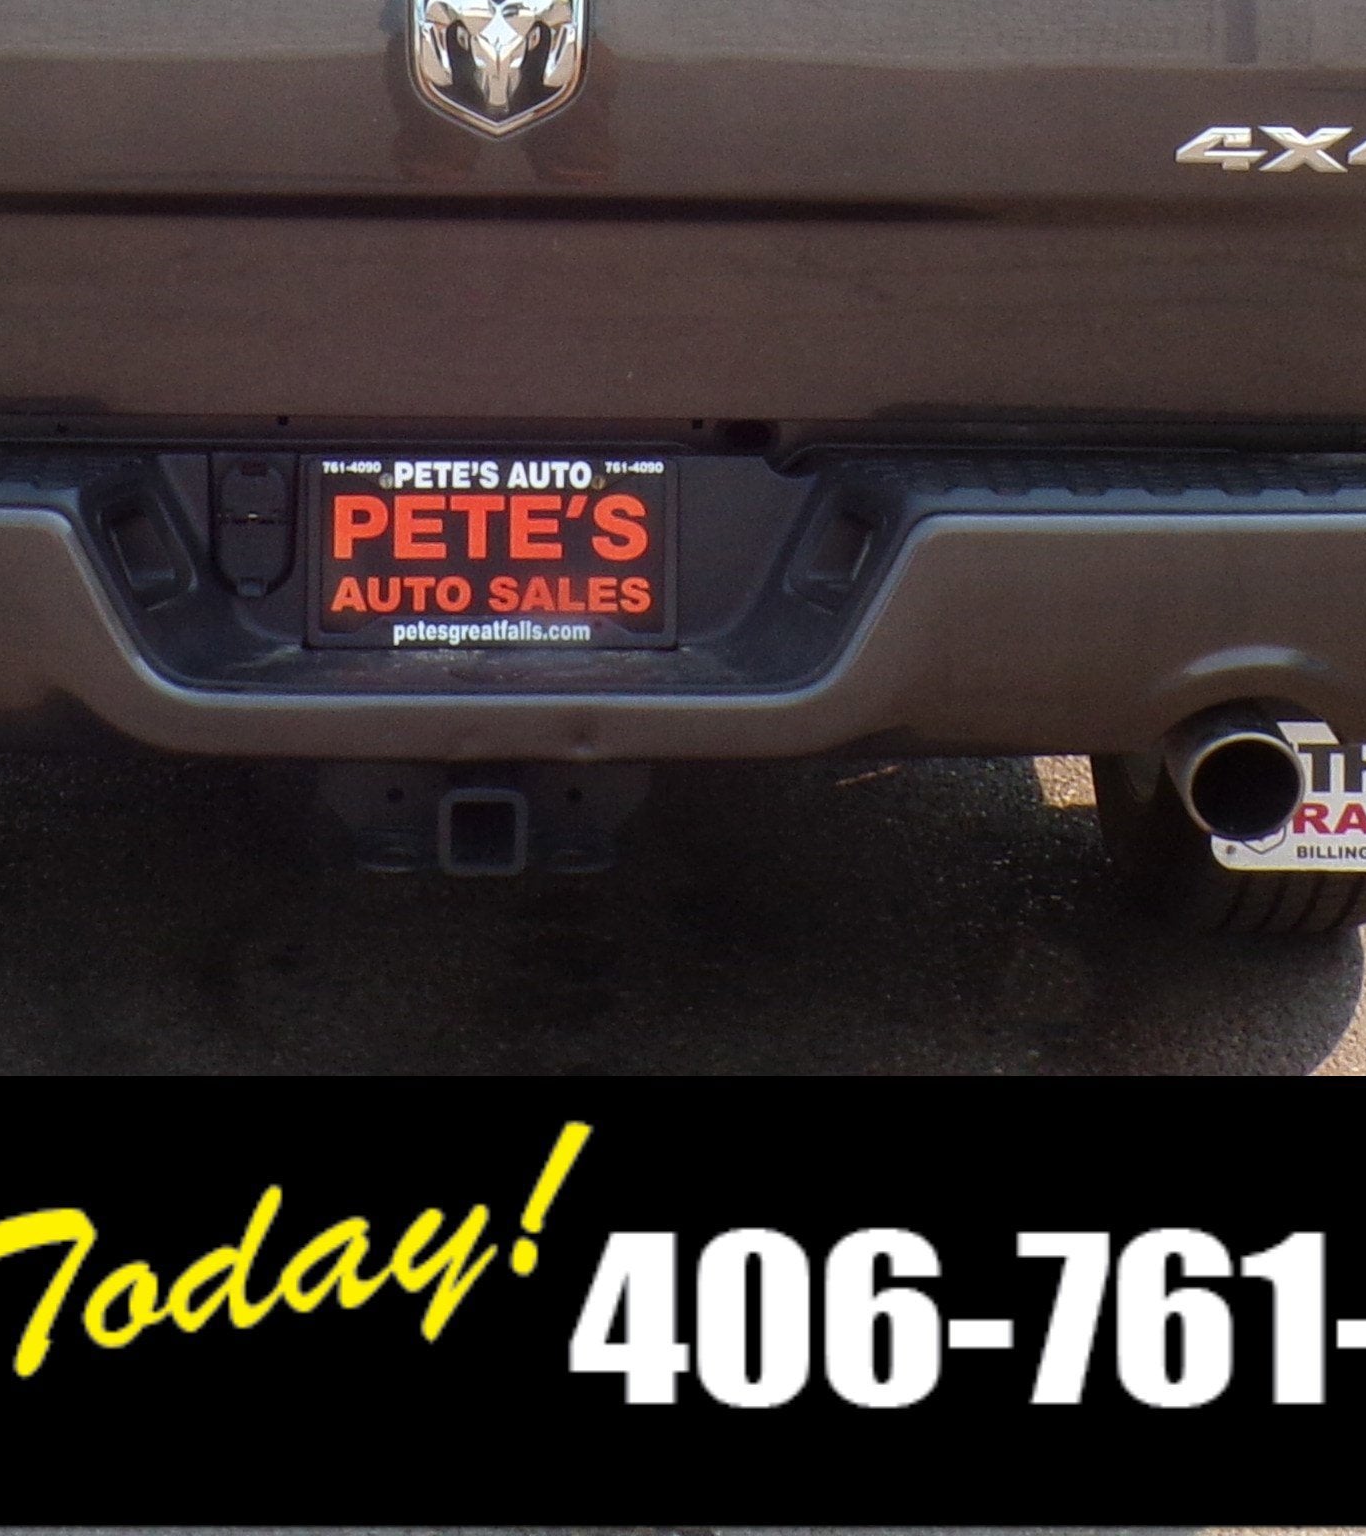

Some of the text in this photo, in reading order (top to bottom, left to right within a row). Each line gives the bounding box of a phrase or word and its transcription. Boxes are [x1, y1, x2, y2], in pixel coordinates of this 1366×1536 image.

[322, 460, 382, 474] 761-4090
[393, 460, 593, 490] PETE'S AUTO
[605, 460, 664, 474] 761-4090
[332, 493, 649, 561] PETE'S
[330, 575, 652, 613] AUTO SALES
[392, 619, 591, 646] petesgreatfalls.com
